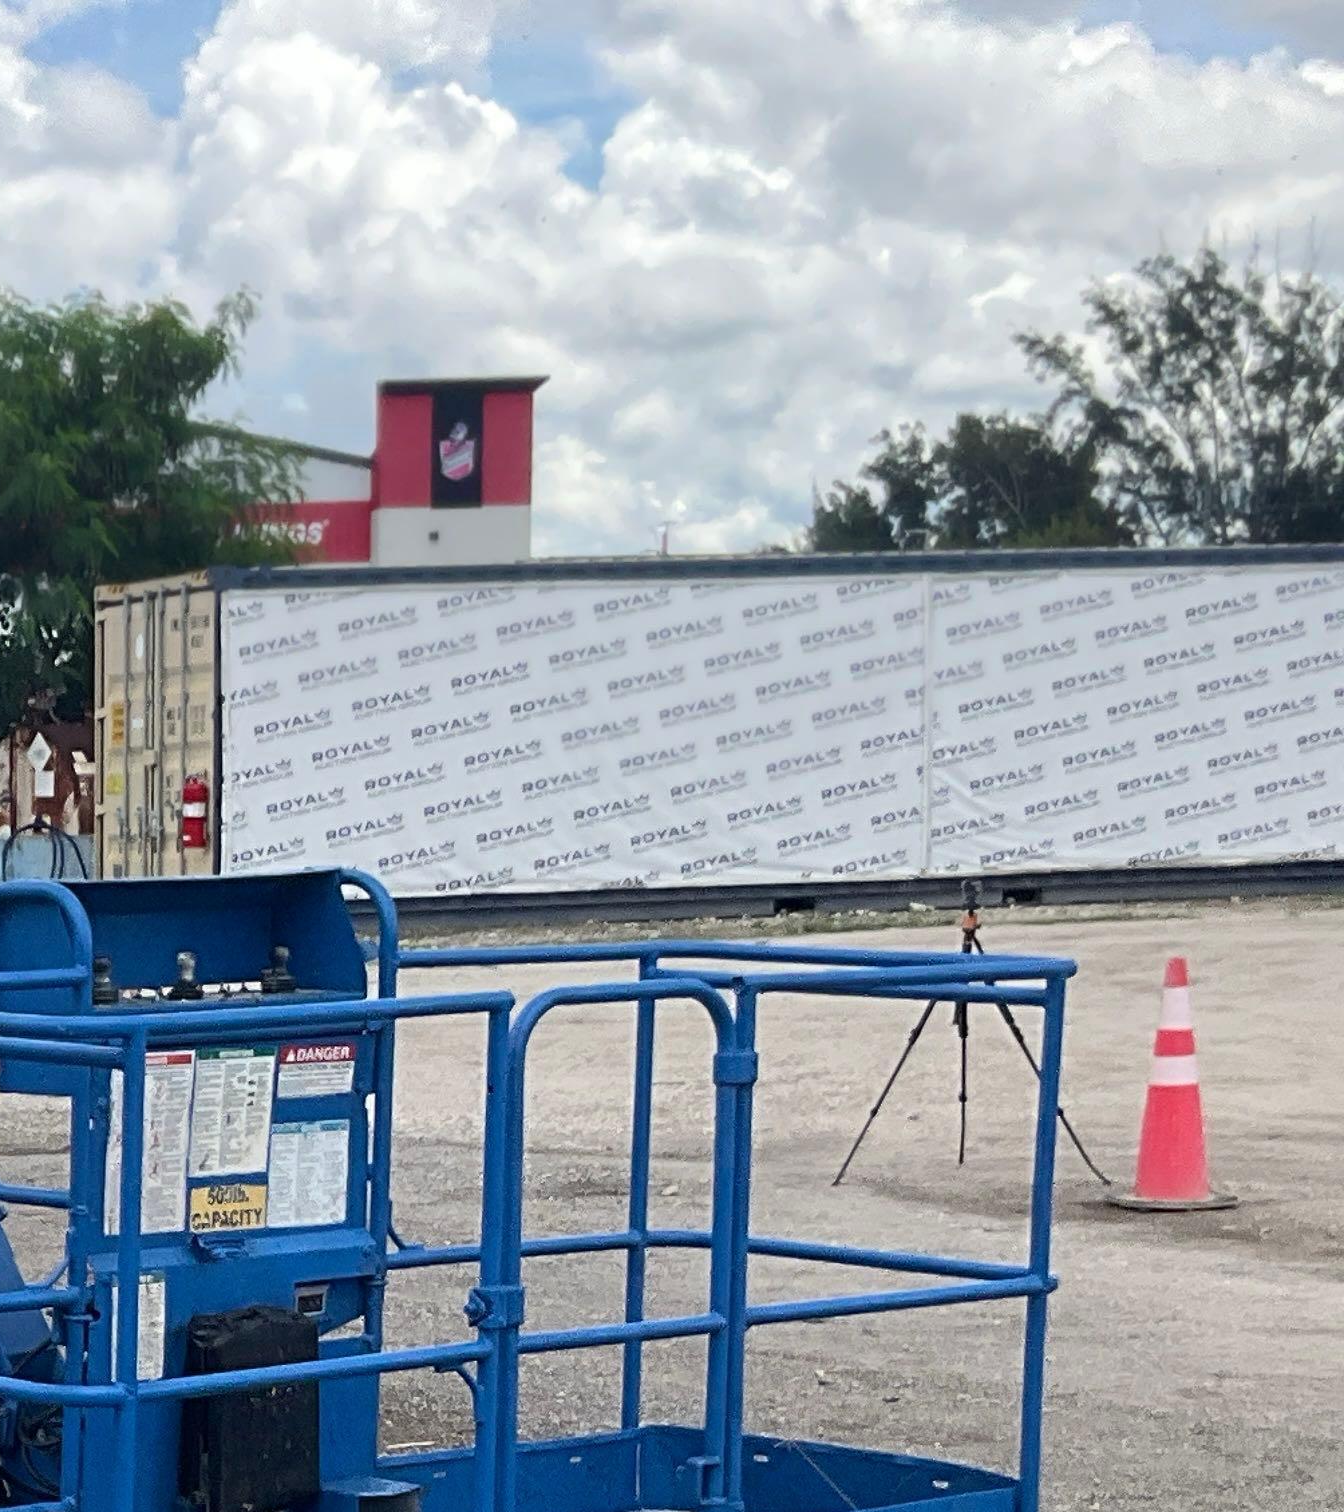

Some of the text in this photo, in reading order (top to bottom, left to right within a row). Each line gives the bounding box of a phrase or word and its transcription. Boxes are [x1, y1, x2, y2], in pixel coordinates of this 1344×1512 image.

[437, 588, 498, 610] ROYAL
[594, 591, 652, 615] ROYAL
[743, 597, 800, 620] ROYAL
[1040, 592, 1095, 615] ROYAL
[1186, 596, 1240, 618] ROYAL
[339, 609, 398, 634] ROYAL
[497, 613, 555, 637] ROYAL
[646, 619, 704, 643] ROYAL
[946, 615, 1003, 638] ROYAL
[1095, 618, 1150, 641] ROYAL
[239, 633, 299, 658] ROYAL
[800, 623, 857, 646] ROYAL
[1234, 624, 1288, 646] ROYAL
[398, 637, 458, 661] ROYAL
[549, 642, 607, 666] ROYAL
[704, 645, 763, 669] ROYAL
[1003, 641, 1059, 664] ROYAL
[1144, 646, 1198, 668] ROYAL
[850, 651, 906, 674] ROYAL
[1286, 650, 1342, 672] ROYAL
[298, 661, 360, 684] ROYAL
[451, 666, 512, 688] ROYAL
[607, 669, 666, 692] ROYAL
[934, 664, 967, 681] YAL
[1052, 668, 1107, 691] ROYAL
[1197, 672, 1251, 694] ROYAL
[229, 685, 263, 702] YAL
[756, 674, 813, 697] ROYAL
[351, 689, 414, 712] ROYAL
[510, 693, 570, 714] ROYAL
[659, 697, 717, 720] ROYAL
[812, 700, 868, 723] ROYAL
[959, 691, 1015, 714] ROYAL
[1107, 694, 1161, 716] ROYAL
[1245, 699, 1299, 721] ROYAL
[254, 714, 314, 736] ROYAL
[411, 716, 472, 738] ROYAL
[561, 719, 621, 744] ROYAL
[716, 723, 774, 746] ROYAL
[1014, 717, 1070, 740] ROYAL
[1155, 721, 1209, 743] ROYAL
[861, 728, 920, 750] ROYAL
[1297, 727, 1344, 747] ROYA
[312, 740, 373, 762] ROYAL
[465, 744, 524, 766] ROYAL
[620, 746, 678, 770] ROYAL
[932, 742, 978, 761] OYAL
[1063, 744, 1119, 767] ROYAL
[1208, 747, 1262, 769] ROYAL
[766, 751, 823, 774] ROYAL
[364, 768, 427, 790] ROYAL
[522, 771, 582, 792] ROYAL
[671, 775, 729, 796] ROYAL
[821, 778, 879, 799] ROYAL
[970, 769, 1026, 790] ROYAL
[1118, 770, 1172, 792] ROYAL
[1255, 774, 1309, 796] ROYAL
[266, 792, 327, 814] ROYAL
[424, 794, 485, 816] ROYAL
[573, 799, 633, 820] ROYAL
[727, 802, 785, 823] ROYAL
[1025, 794, 1081, 815] ROYAL
[1165, 797, 1219, 819] ROYAL
[1307, 803, 1344, 820] ROY
[870, 807, 920, 827] ROYA
[931, 816, 987, 839] ROYAL
[326, 819, 386, 841] ROYAL
[477, 822, 536, 844] ROYAL
[630, 824, 690, 846] ROYAL
[777, 827, 833, 850] ROYAL
[1074, 819, 1129, 842] ROYAL
[1218, 821, 1272, 843] ROYAL
[378, 845, 439, 867] ROYAL
[534, 848, 592, 869] ROYAL
[680, 851, 740, 873] ROYAL
[832, 854, 889, 876] ROYAL
[981, 844, 1038, 865] ROYAL
[296, 1045, 351, 1062] DANGER
[192, 1207, 263, 1230] CAPACITY
